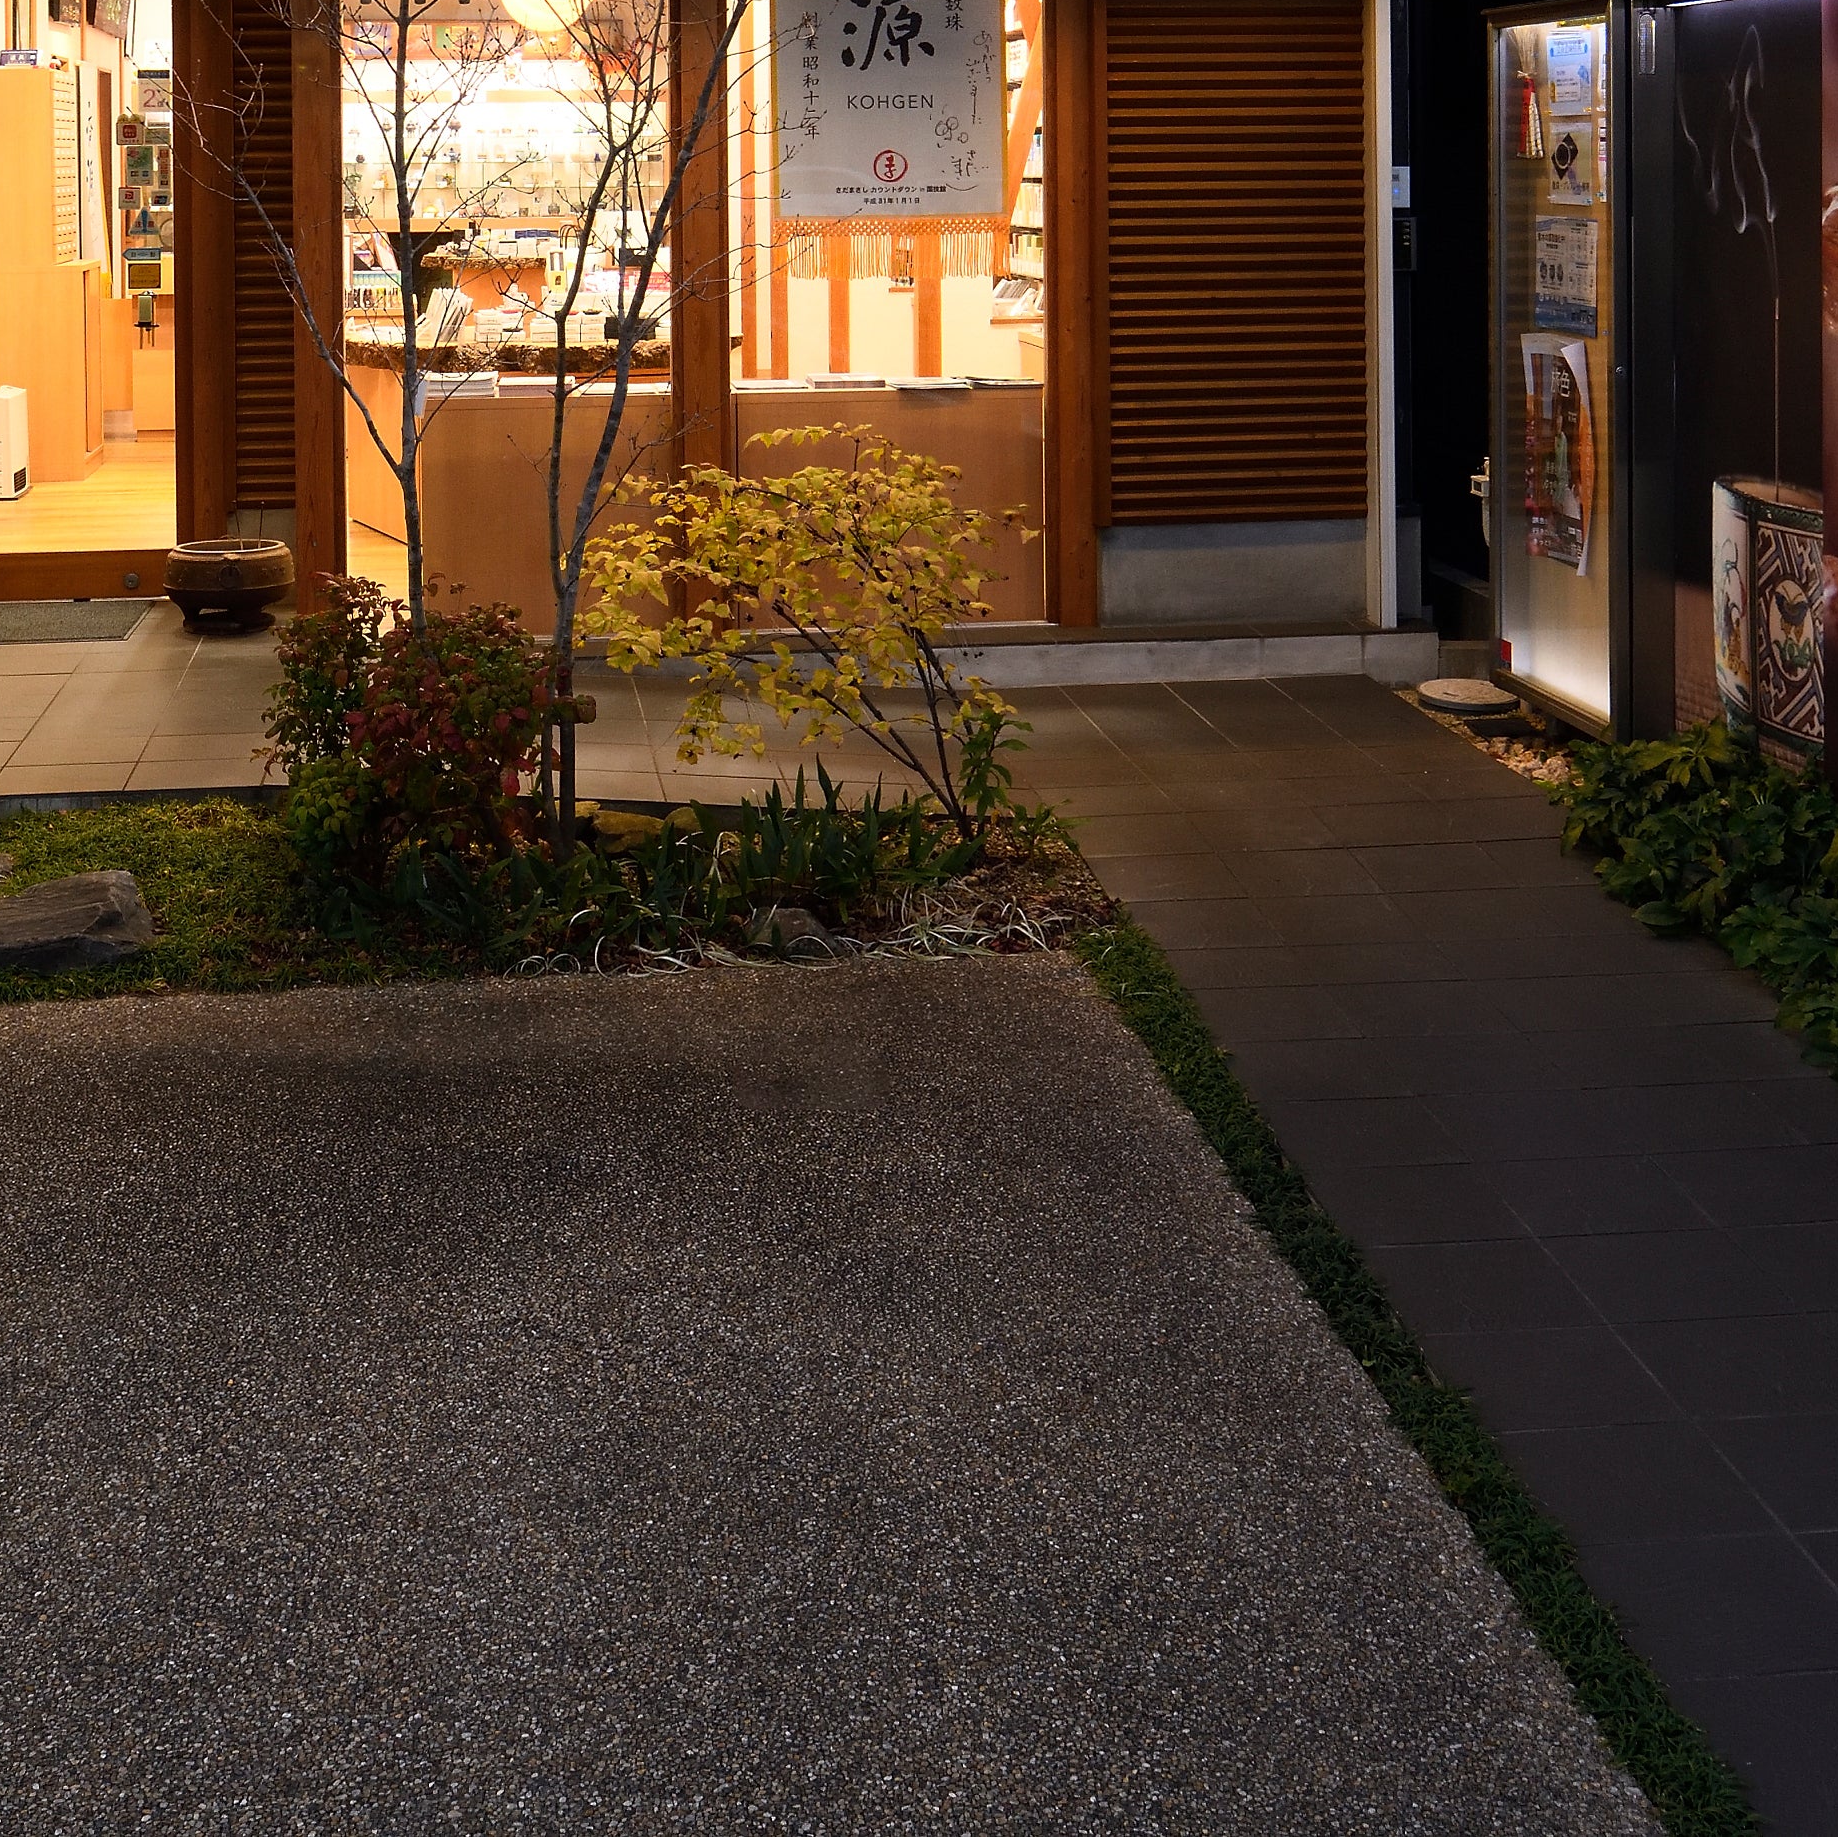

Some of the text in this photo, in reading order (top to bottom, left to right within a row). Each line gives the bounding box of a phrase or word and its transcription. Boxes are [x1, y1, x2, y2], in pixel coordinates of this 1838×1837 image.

[847, 94, 934, 110] KOHGEN
[835, 186, 868, 194] さだまさし
[870, 185, 918, 193] カウントダウン
